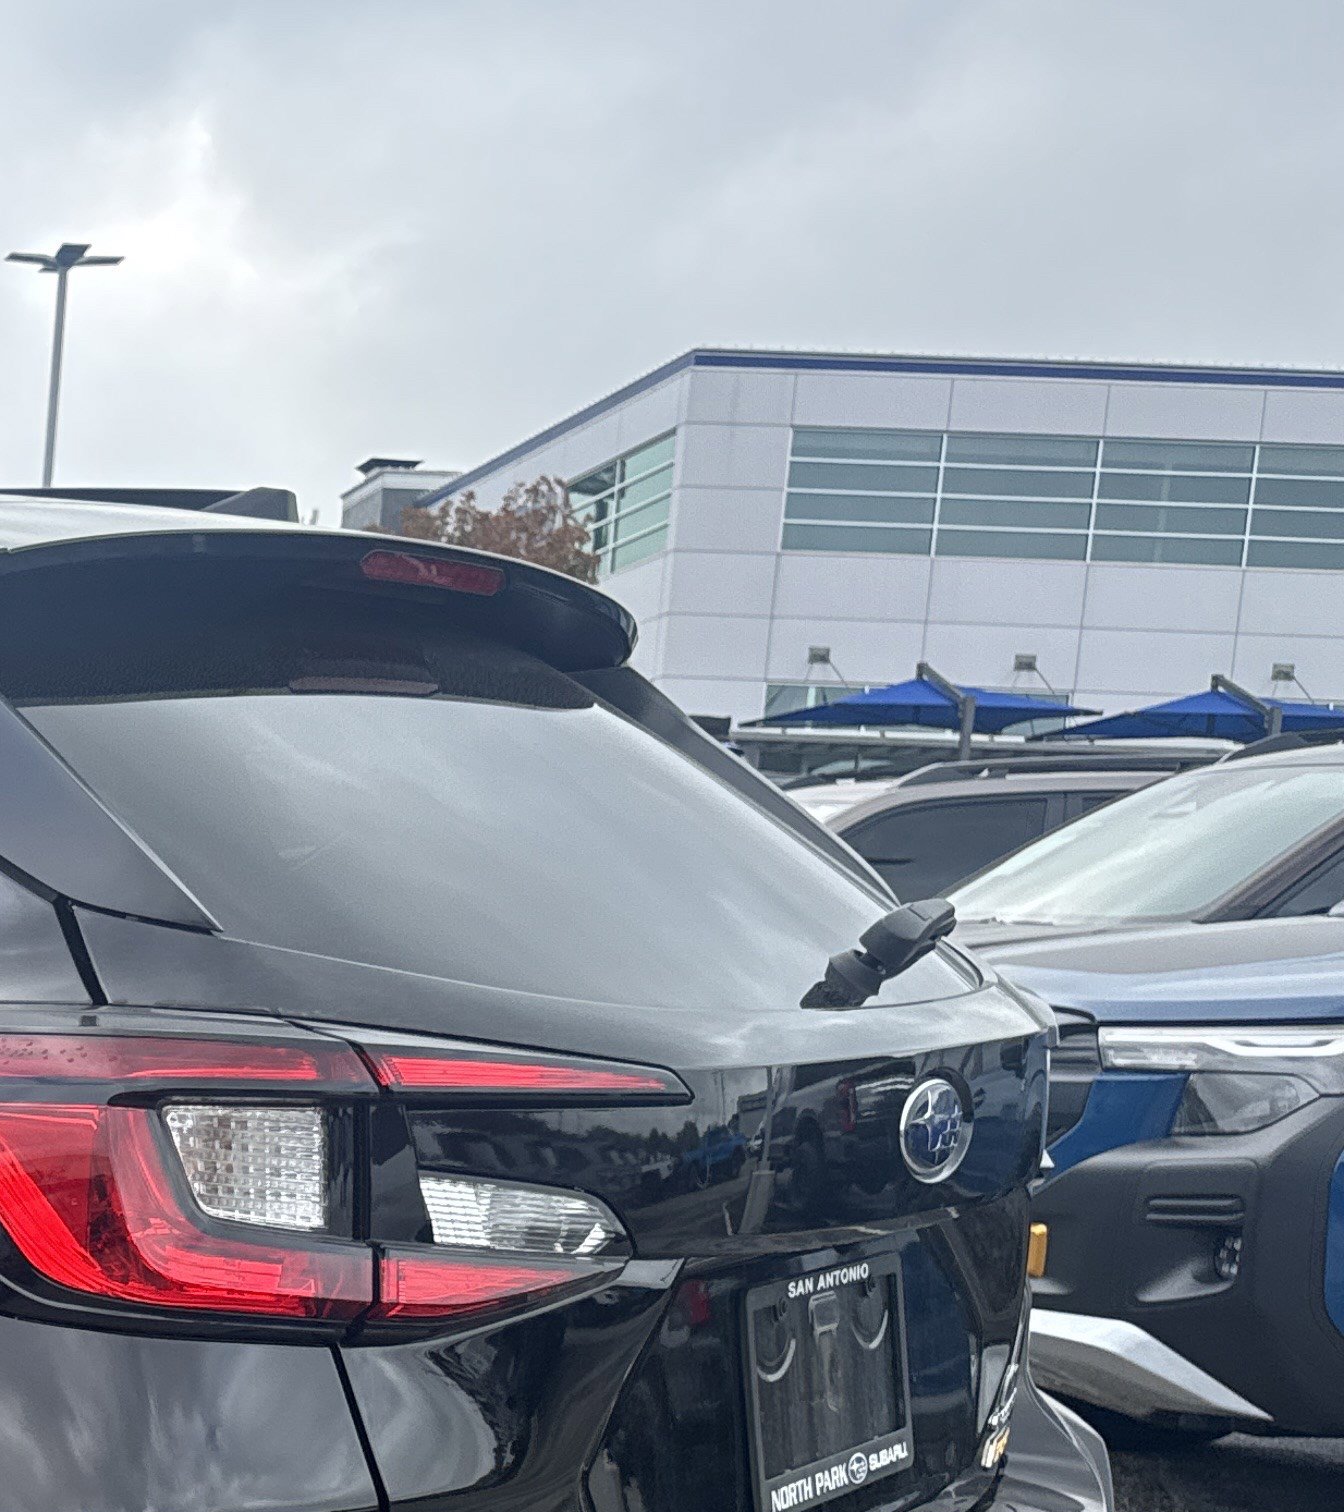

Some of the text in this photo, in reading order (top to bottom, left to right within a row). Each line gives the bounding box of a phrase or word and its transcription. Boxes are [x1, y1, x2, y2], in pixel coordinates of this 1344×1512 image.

[787, 1262, 869, 1298] SAN ANTONIO
[814, 1462, 849, 1497] PARK
[868, 1441, 909, 1471] SUBARU
